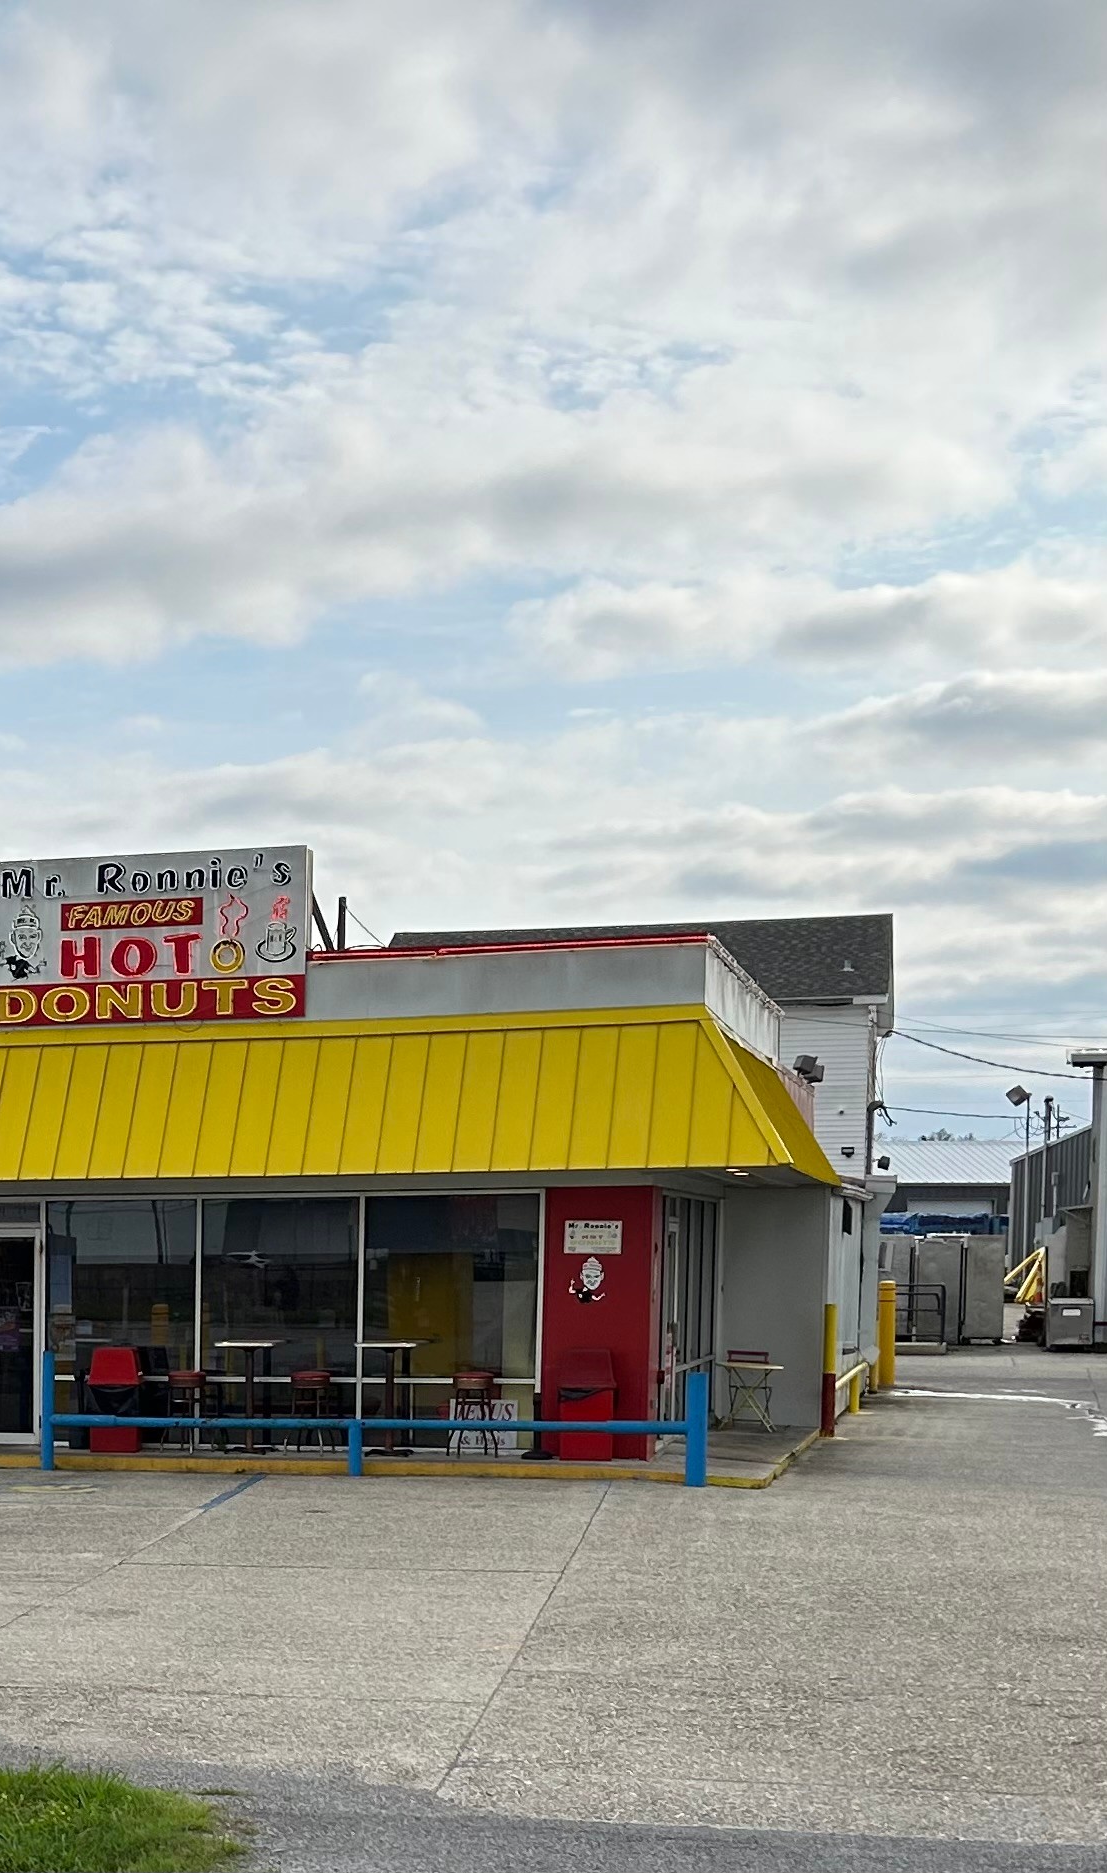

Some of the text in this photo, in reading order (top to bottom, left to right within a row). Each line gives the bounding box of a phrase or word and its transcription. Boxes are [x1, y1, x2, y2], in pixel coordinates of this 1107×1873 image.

[1, 853, 293, 899] Mr. Ronnie's
[67, 900, 196, 928] FAMOUS
[59, 932, 203, 980] HOT
